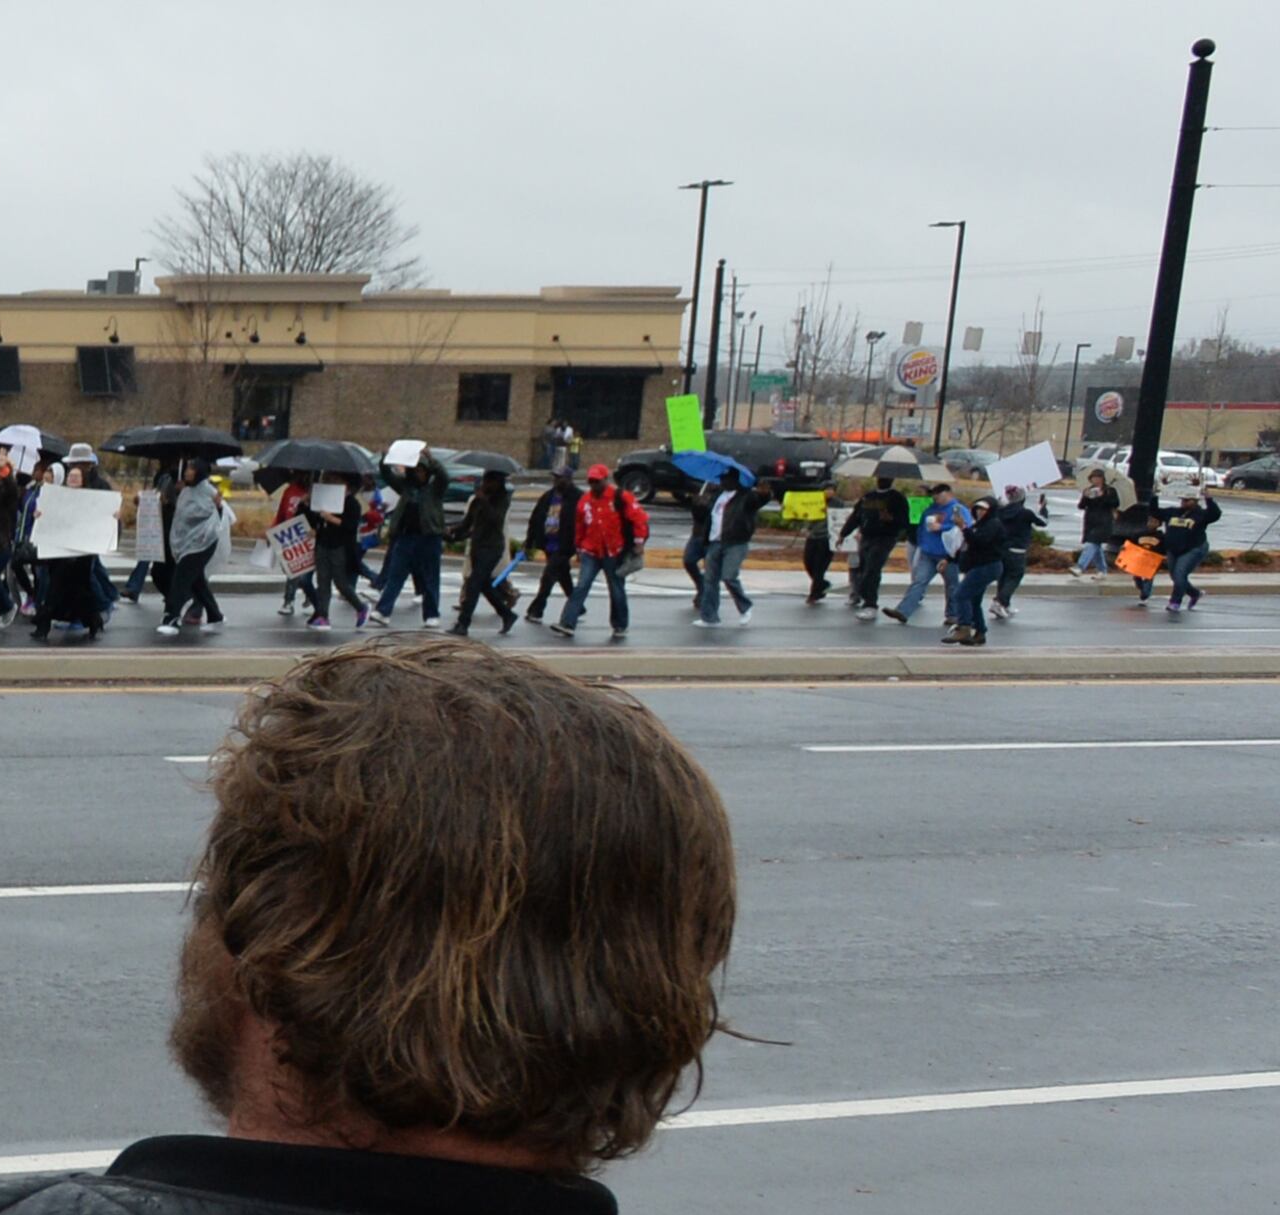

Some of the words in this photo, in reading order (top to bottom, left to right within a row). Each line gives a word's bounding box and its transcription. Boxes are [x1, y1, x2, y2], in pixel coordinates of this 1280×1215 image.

[903, 363, 938, 384] KING
[273, 521, 308, 544] WE
[282, 540, 313, 561] ONE
